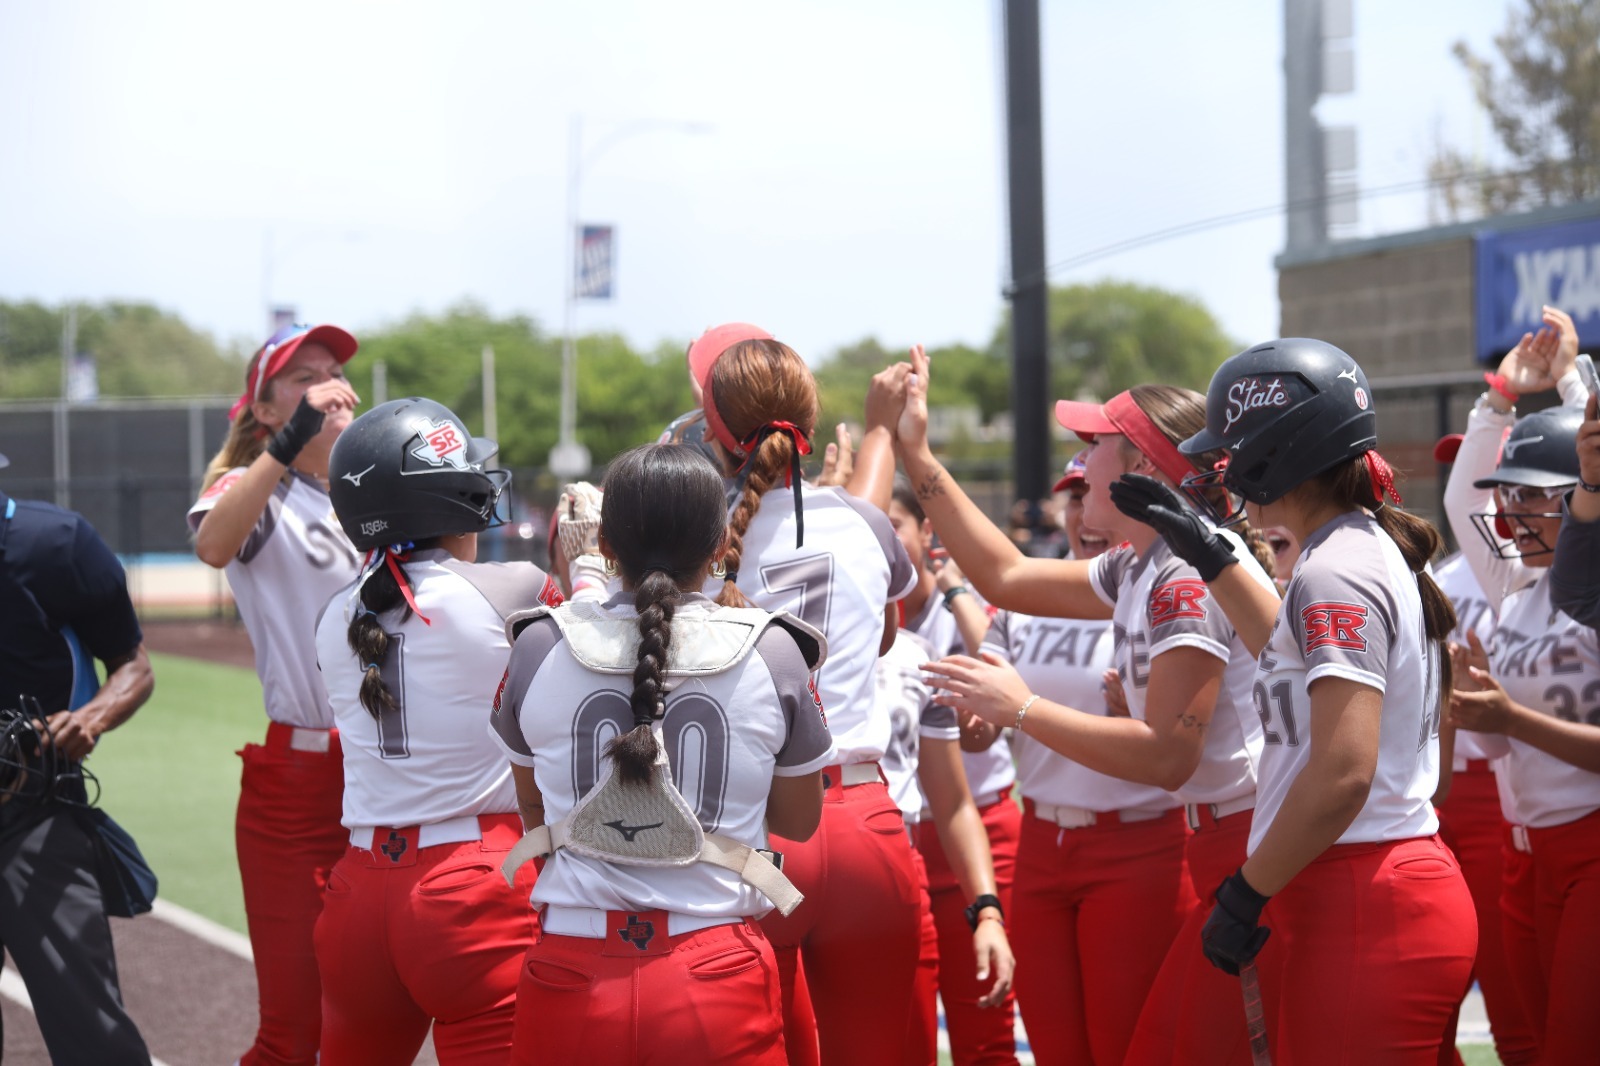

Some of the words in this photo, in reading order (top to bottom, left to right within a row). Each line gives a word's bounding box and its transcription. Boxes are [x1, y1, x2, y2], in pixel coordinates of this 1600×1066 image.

[1223, 378, 1288, 434] State
[1356, 390, 1367, 408] 21
[429, 427, 460, 454] SR
[759, 552, 834, 690] 7
[1151, 580, 1207, 623] SR
[1303, 606, 1368, 648] SR
[1488, 625, 1584, 676] STATE
[359, 632, 411, 759] 1
[1253, 679, 1299, 747] 21
[571, 688, 730, 834] 00
